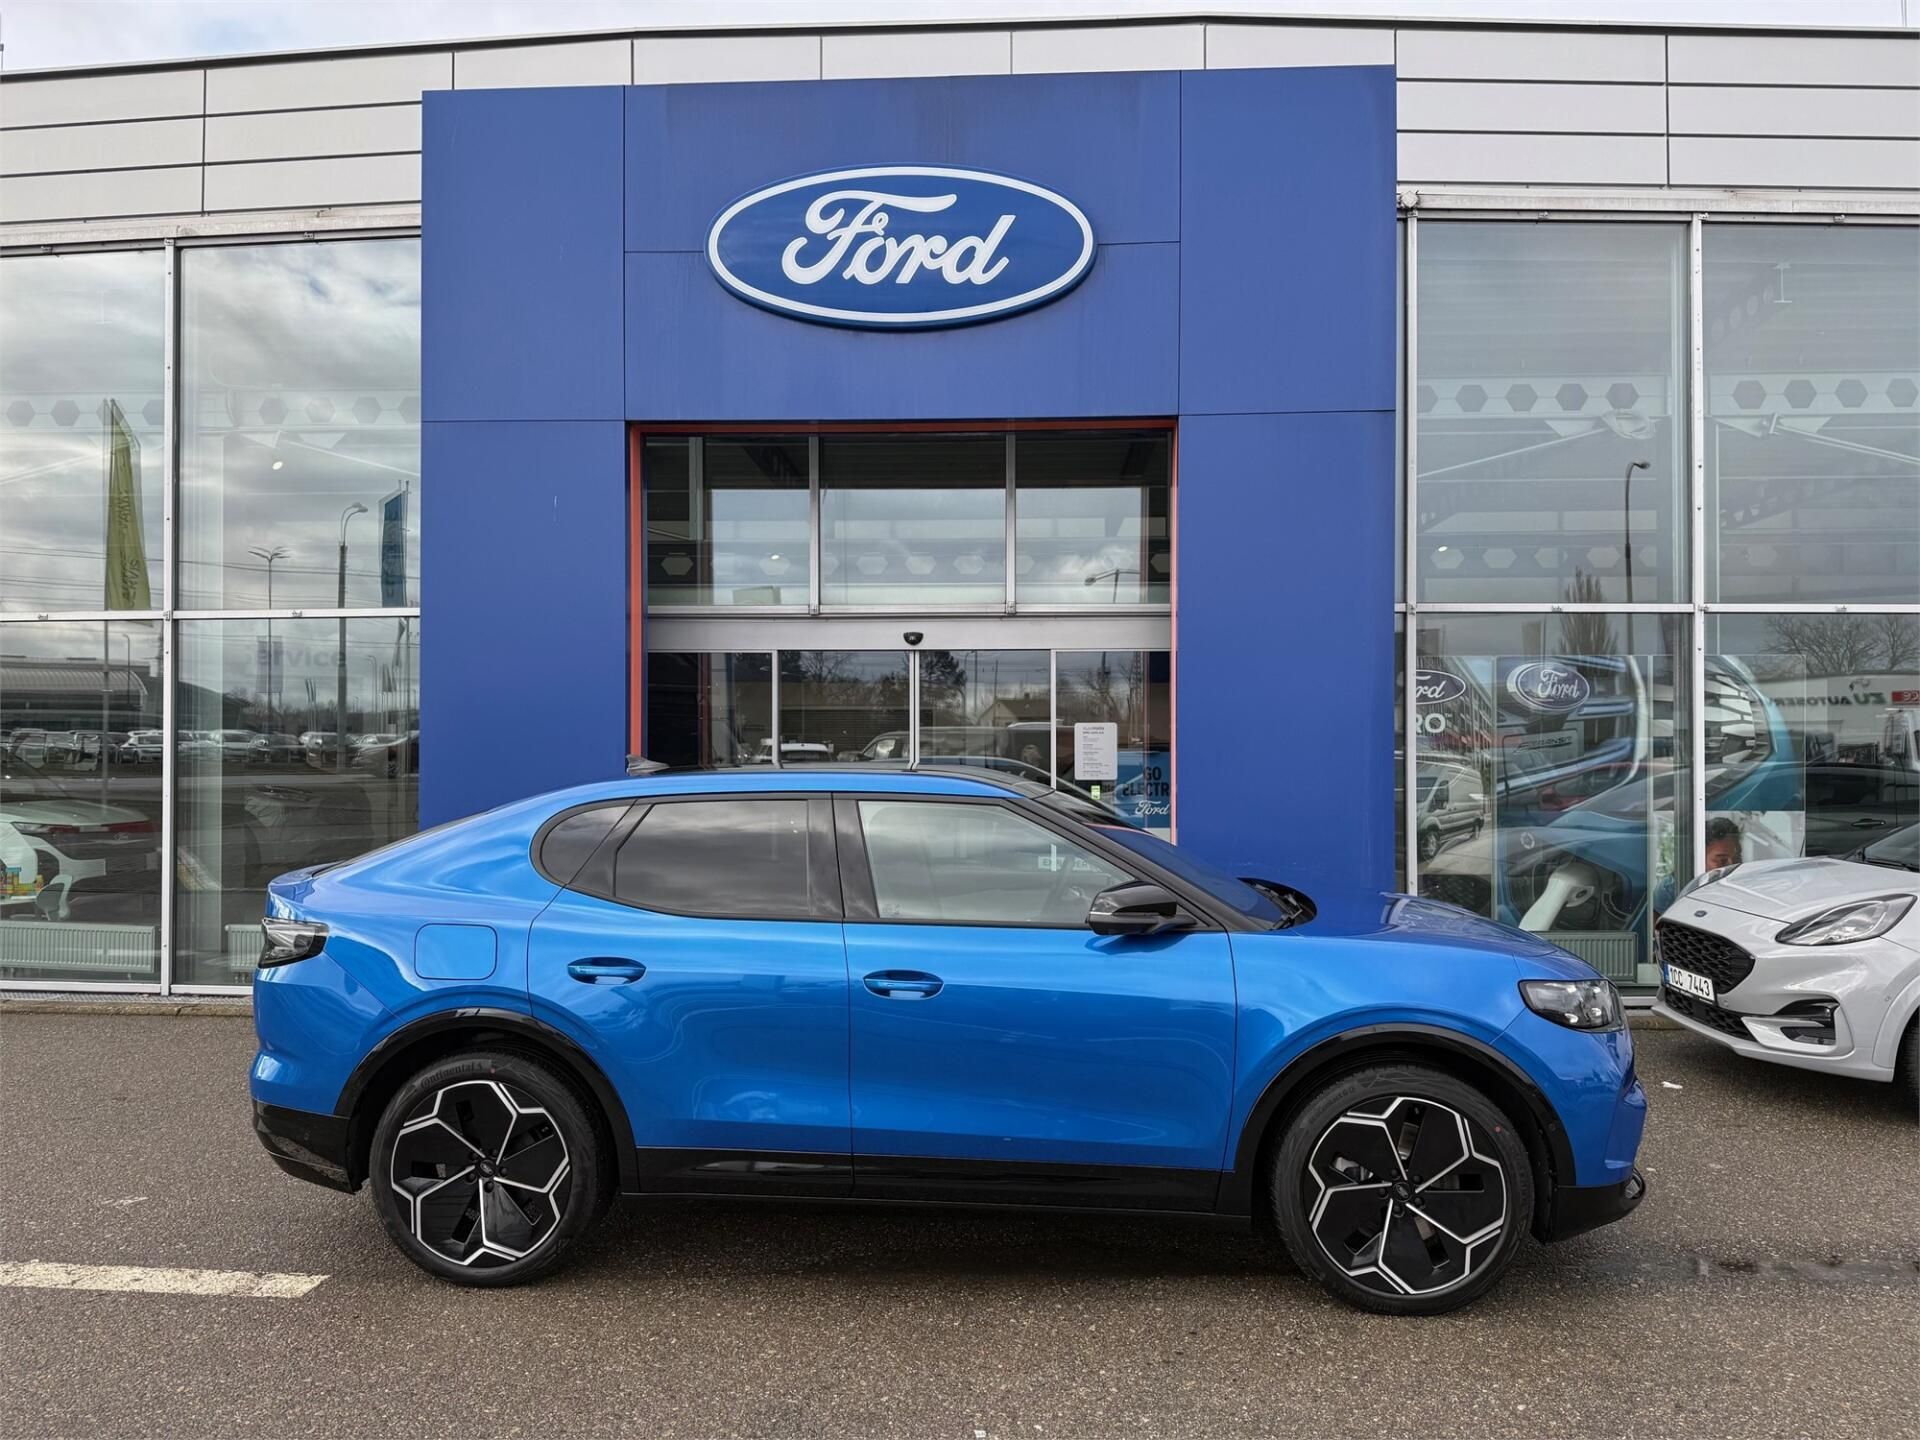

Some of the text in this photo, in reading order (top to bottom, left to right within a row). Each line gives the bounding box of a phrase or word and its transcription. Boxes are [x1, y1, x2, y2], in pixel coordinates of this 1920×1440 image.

[781, 190, 1016, 285] Ford
[1416, 675, 1448, 699] rd
[1537, 669, 1580, 698] Ford
[1143, 766, 1162, 781] GO
[1135, 799, 1170, 816] Ford
[1688, 973, 1710, 996] 7443
[421, 1063, 474, 1088] Continental
